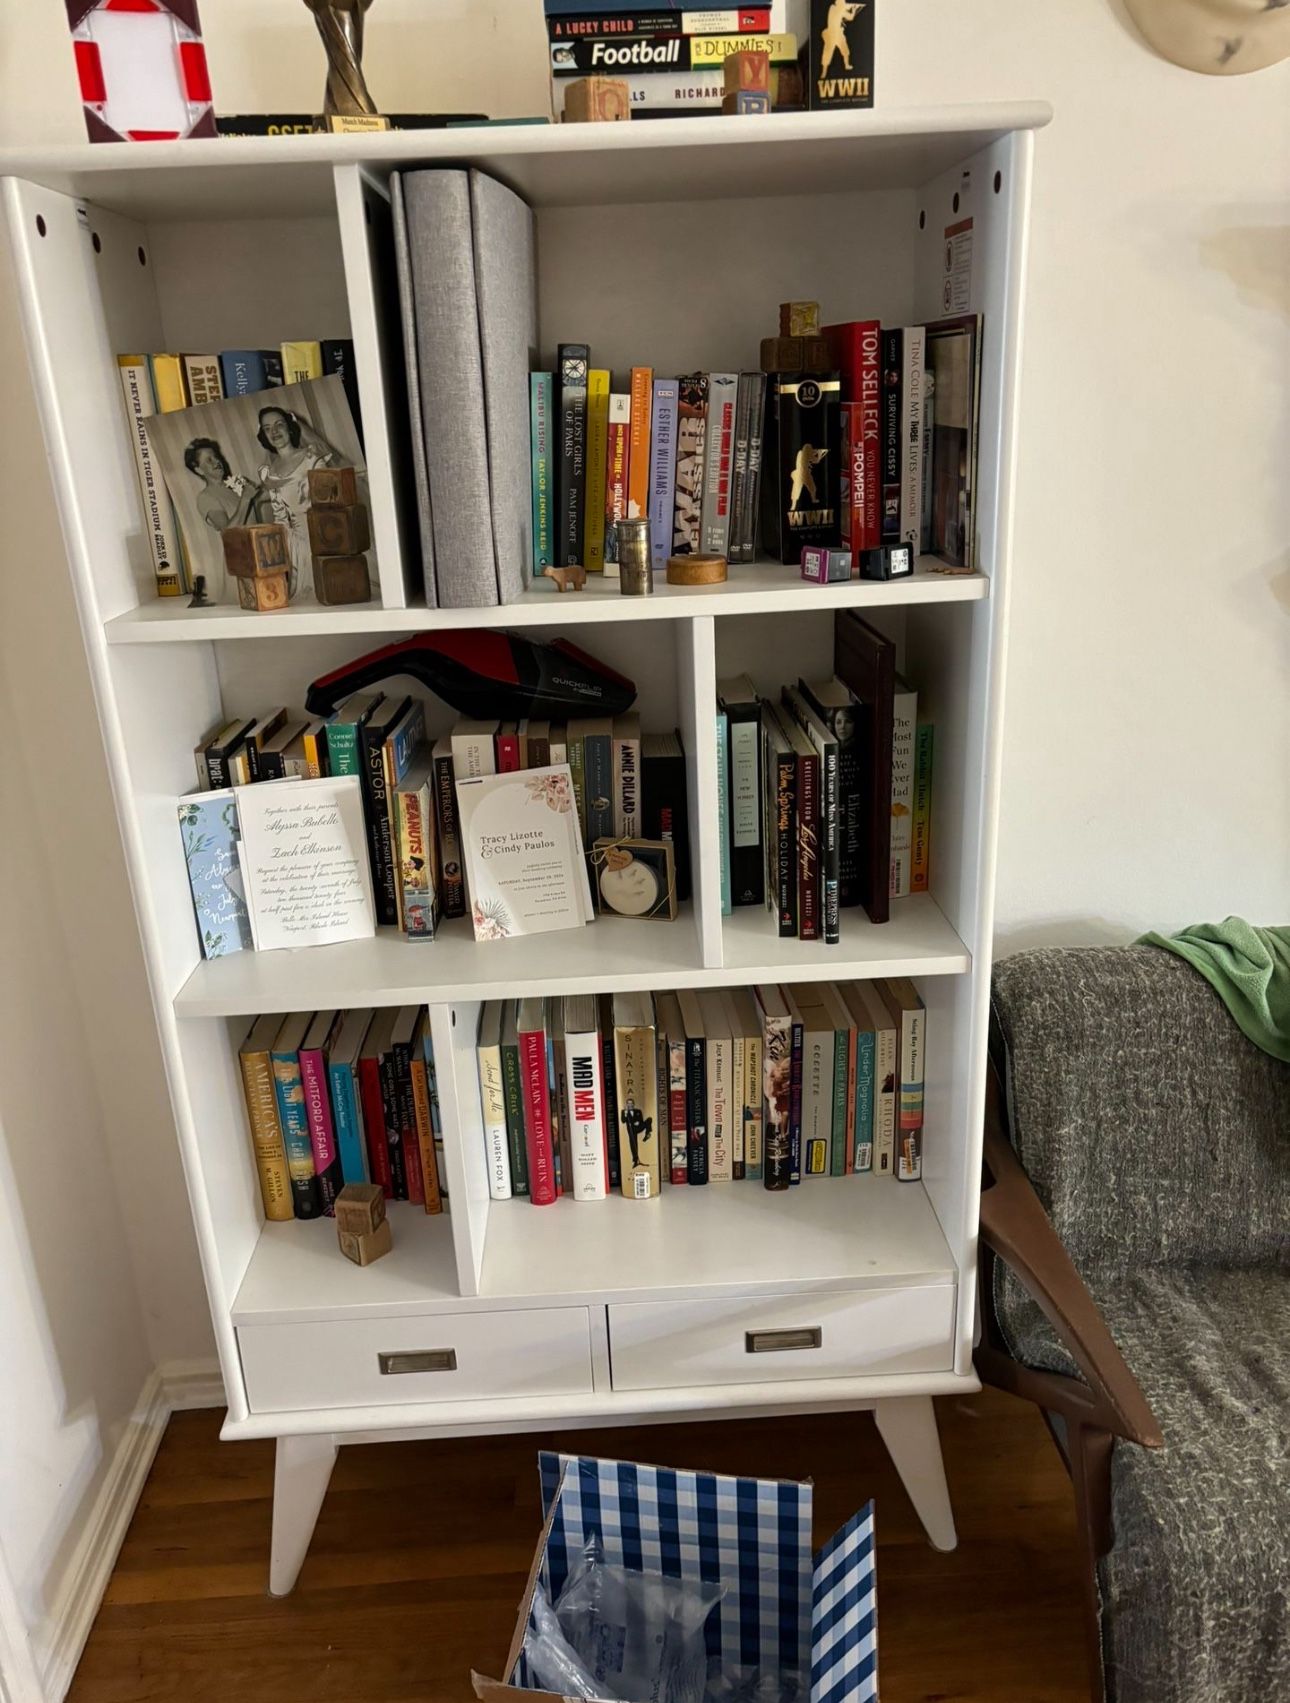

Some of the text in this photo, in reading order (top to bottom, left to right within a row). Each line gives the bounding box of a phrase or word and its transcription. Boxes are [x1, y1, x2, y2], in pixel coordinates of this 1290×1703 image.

[555, 22, 562, 34] A
[566, 21, 599, 34] LUCKY
[602, 19, 634, 32] CHILD
[591, 40, 679, 65] Football
[704, 39, 775, 56] DUMMIES
[674, 87, 726, 99] RICHARD
[817, 77, 870, 98] WWII
[910, 340, 921, 368] TINA
[801, 386, 816, 395] 10
[910, 369, 920, 399] COLE
[910, 401, 920, 419] MY
[565, 410, 574, 458] OF PARIS
[574, 416, 583, 444] LOST
[862, 327, 879, 529] TOM SELLECK YOU NEVER KNOW
[888, 393, 897, 477] SURVIVING CISSY
[127, 370, 162, 531] IT NEVER RAINS IN TIGER STADIUM
[574, 444, 583, 477] GIRLS
[655, 407, 671, 496] ESTHER WILLIAMS
[537, 381, 547, 551] MALIBU RISING TAYLOR JENKINS REID
[614, 457, 623, 474] TIME
[690, 417, 706, 548] CLASSICS
[853, 453, 865, 508] POMPEII
[568, 487, 577, 545] PAM JENOFF
[612, 482, 623, 528] HOLLYWOD
[787, 510, 834, 525] WWII
[208, 758, 223, 785] brat:
[337, 754, 351, 776] The
[440, 762, 448, 777] THE
[621, 744, 635, 773] ANNIE
[828, 755, 837, 771] 100
[804, 760, 812, 799] GREETINGS
[828, 771, 837, 793] YEARS
[440, 777, 453, 823] EMPERORS
[621, 776, 636, 814] DILLARD
[914, 732, 929, 866] The Rabbit Hutch Tess Gunty
[368, 747, 395, 900] ASTOR Anderson Cooper
[403, 792, 423, 855] PEANUTS
[778, 763, 795, 881] Palm Springs HOLIDAY
[804, 801, 812, 821] FROM
[828, 803, 836, 821] MISS
[847, 793, 861, 853] Elizabeth
[263, 817, 298, 835] Alyssa
[480, 829, 543, 847] Tracy Lizotte
[828, 821, 836, 852] AMERICA
[270, 845, 299, 858] Zach
[481, 839, 555, 859] & Cindy Paulos
[799, 842, 817, 881] Angeles
[527, 1036, 538, 1067] PAULA
[715, 1042, 724, 1058] JACK
[767, 1030, 786, 1061] Kin
[486, 1059, 498, 1083] Send
[624, 1034, 634, 1095] SINATRA
[749, 1052, 757, 1104] WAPSHOT CHRONICLE
[910, 1048, 919, 1082] Afternoons
[506, 1052, 519, 1116] CROSS CREEK
[572, 1056, 595, 1121] MAD MEN
[714, 1087, 724, 1099] The
[837, 1082, 845, 1107] PARIS
[856, 1042, 874, 1121] Under Magnolia
[255, 1062, 277, 1139] AMERICA'S
[305, 1059, 328, 1160] THE MITFORD AFFAIR
[658, 1096, 667, 1105] OF
[694, 1098, 704, 1124] SISTERS
[714, 1098, 726, 1123] Town
[286, 1103, 299, 1136] YEARS
[418, 1104, 430, 1137] DARWIN
[659, 1109, 667, 1127] MAN
[883, 1098, 892, 1147] RHODA
[534, 1121, 546, 1149] LOVE
[714, 1138, 724, 1149] The
[750, 1137, 758, 1159] CHEEVER
[492, 1129, 504, 1182] LAUREN FOX
[712, 1149, 727, 1167] City
[273, 1171, 284, 1198] STEVEN
[538, 1158, 548, 1183] RUIN
[267, 1176, 276, 1203] GILLON
